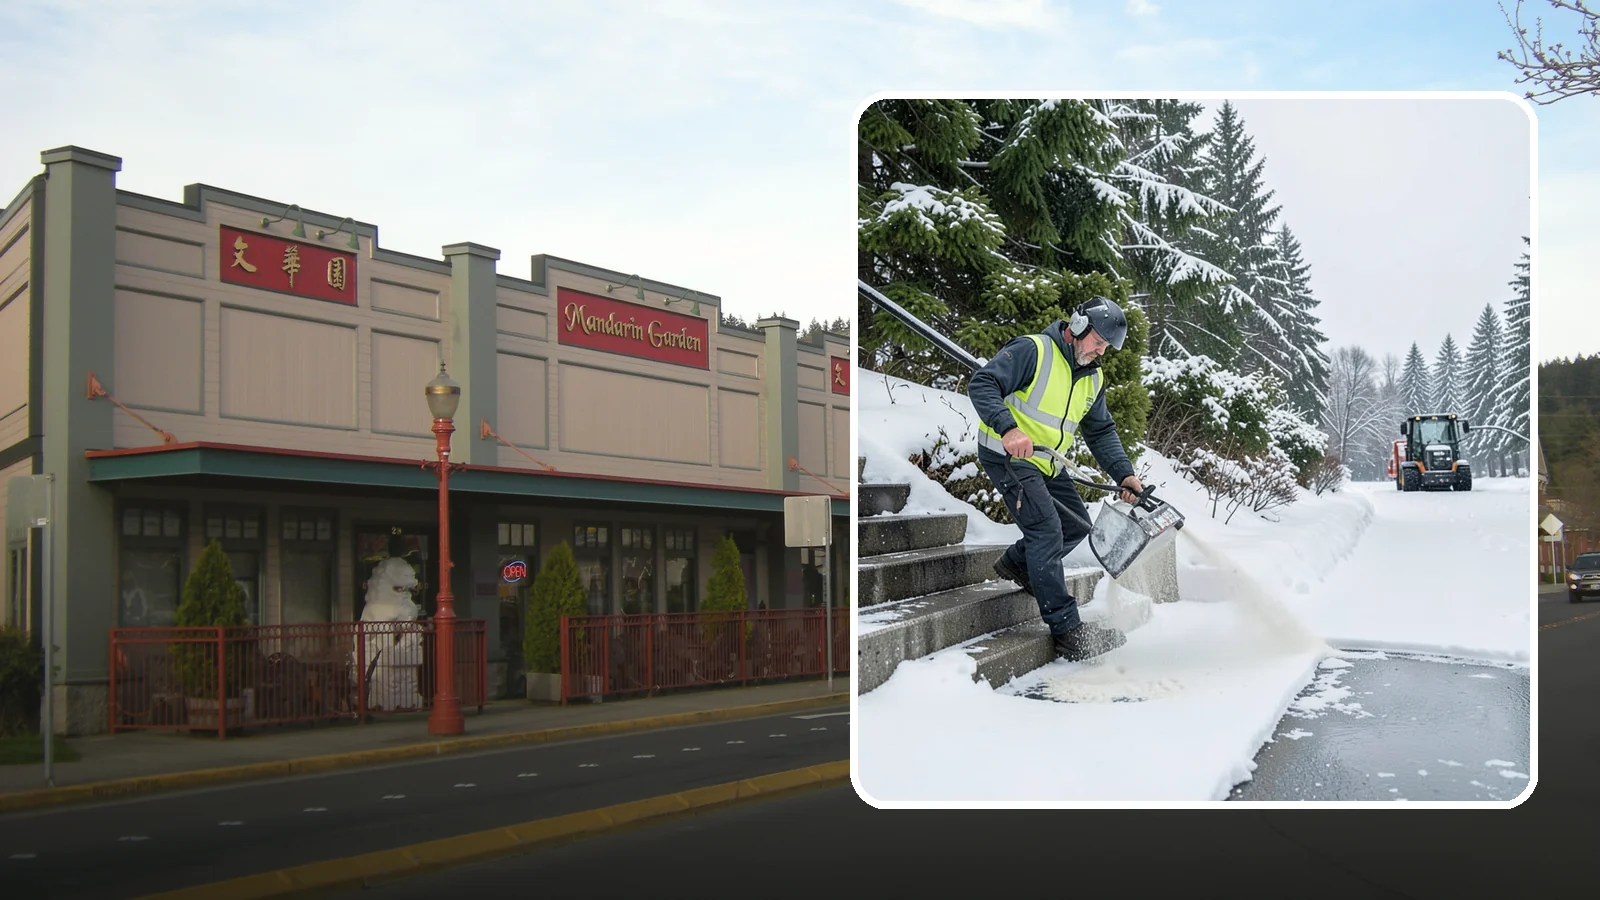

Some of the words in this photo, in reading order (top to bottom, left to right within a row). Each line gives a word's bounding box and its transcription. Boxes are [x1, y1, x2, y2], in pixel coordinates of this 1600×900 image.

[230, 235, 346, 291] 文華園
[564, 302, 644, 341] Mandarin
[648, 320, 701, 352] Garden
[503, 565, 526, 578] OPEN
